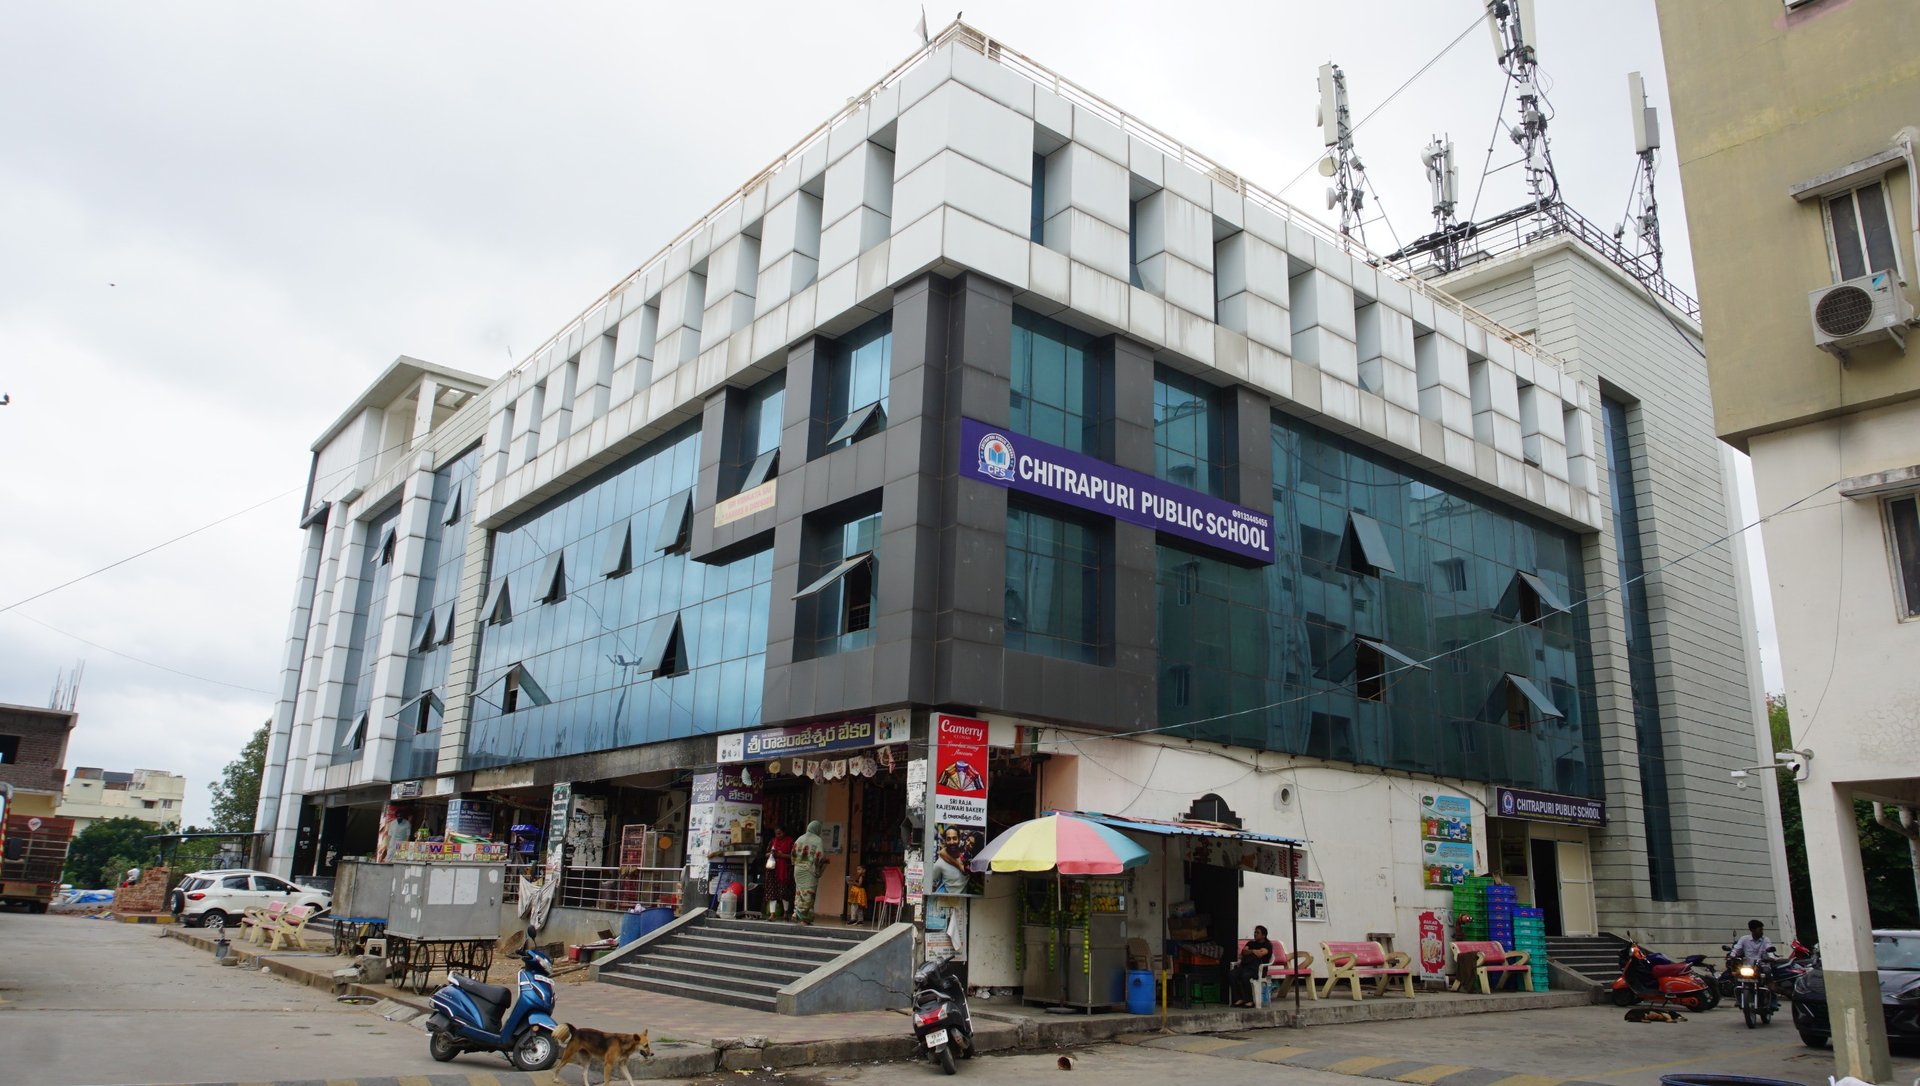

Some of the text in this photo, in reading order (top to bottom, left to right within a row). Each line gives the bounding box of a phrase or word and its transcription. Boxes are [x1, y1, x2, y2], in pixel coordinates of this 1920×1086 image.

[988, 465, 1006, 477] CPS
[1019, 455, 1270, 552] CHITRAPURI PUBLIC SCHOOL
[747, 734, 760, 754] శ్రీ
[838, 722, 871, 741] బేకరి
[941, 719, 984, 741] Camerry
[936, 803, 965, 811] RAJESWARI
[1516, 798, 1555, 814] CHITRAPURI
[1555, 803, 1577, 817] PUBLIC
[1577, 806, 1600, 819] SCHOOL
[430, 843, 508, 854] WEL COME
